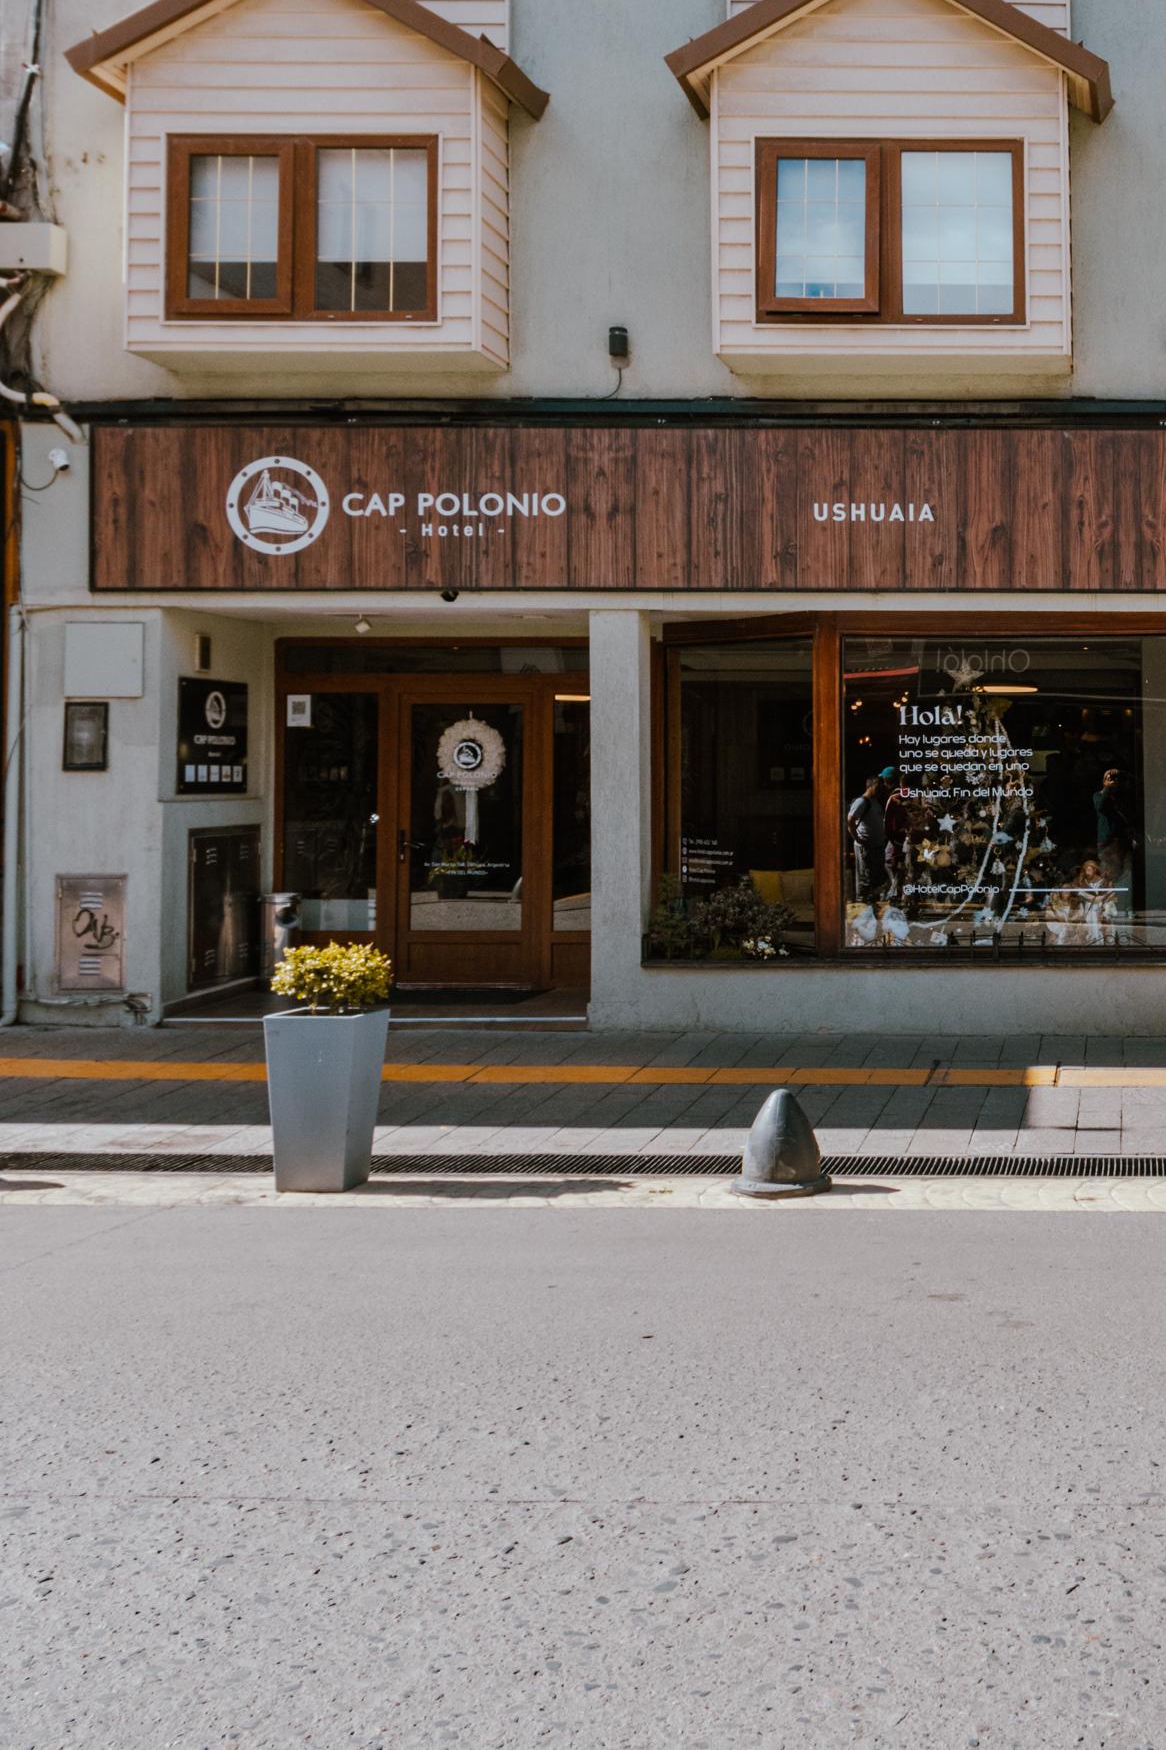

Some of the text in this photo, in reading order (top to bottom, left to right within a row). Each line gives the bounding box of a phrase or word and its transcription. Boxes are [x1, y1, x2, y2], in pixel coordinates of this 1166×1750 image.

[342, 492, 567, 517] CAP POLONIO
[813, 503, 935, 522] USHUAIA
[421, 522, 484, 537] Hotel
[899, 705, 963, 725] Hola!
[899, 734, 1007, 747] Hay lugares donde
[899, 747, 1033, 760] uno se queda y lugares
[899, 761, 1029, 774] que se quedan en uno
[900, 786, 1033, 798] Ushuaia, Fin del Mundo
[903, 883, 1000, 896] @HotelCapPolonio
